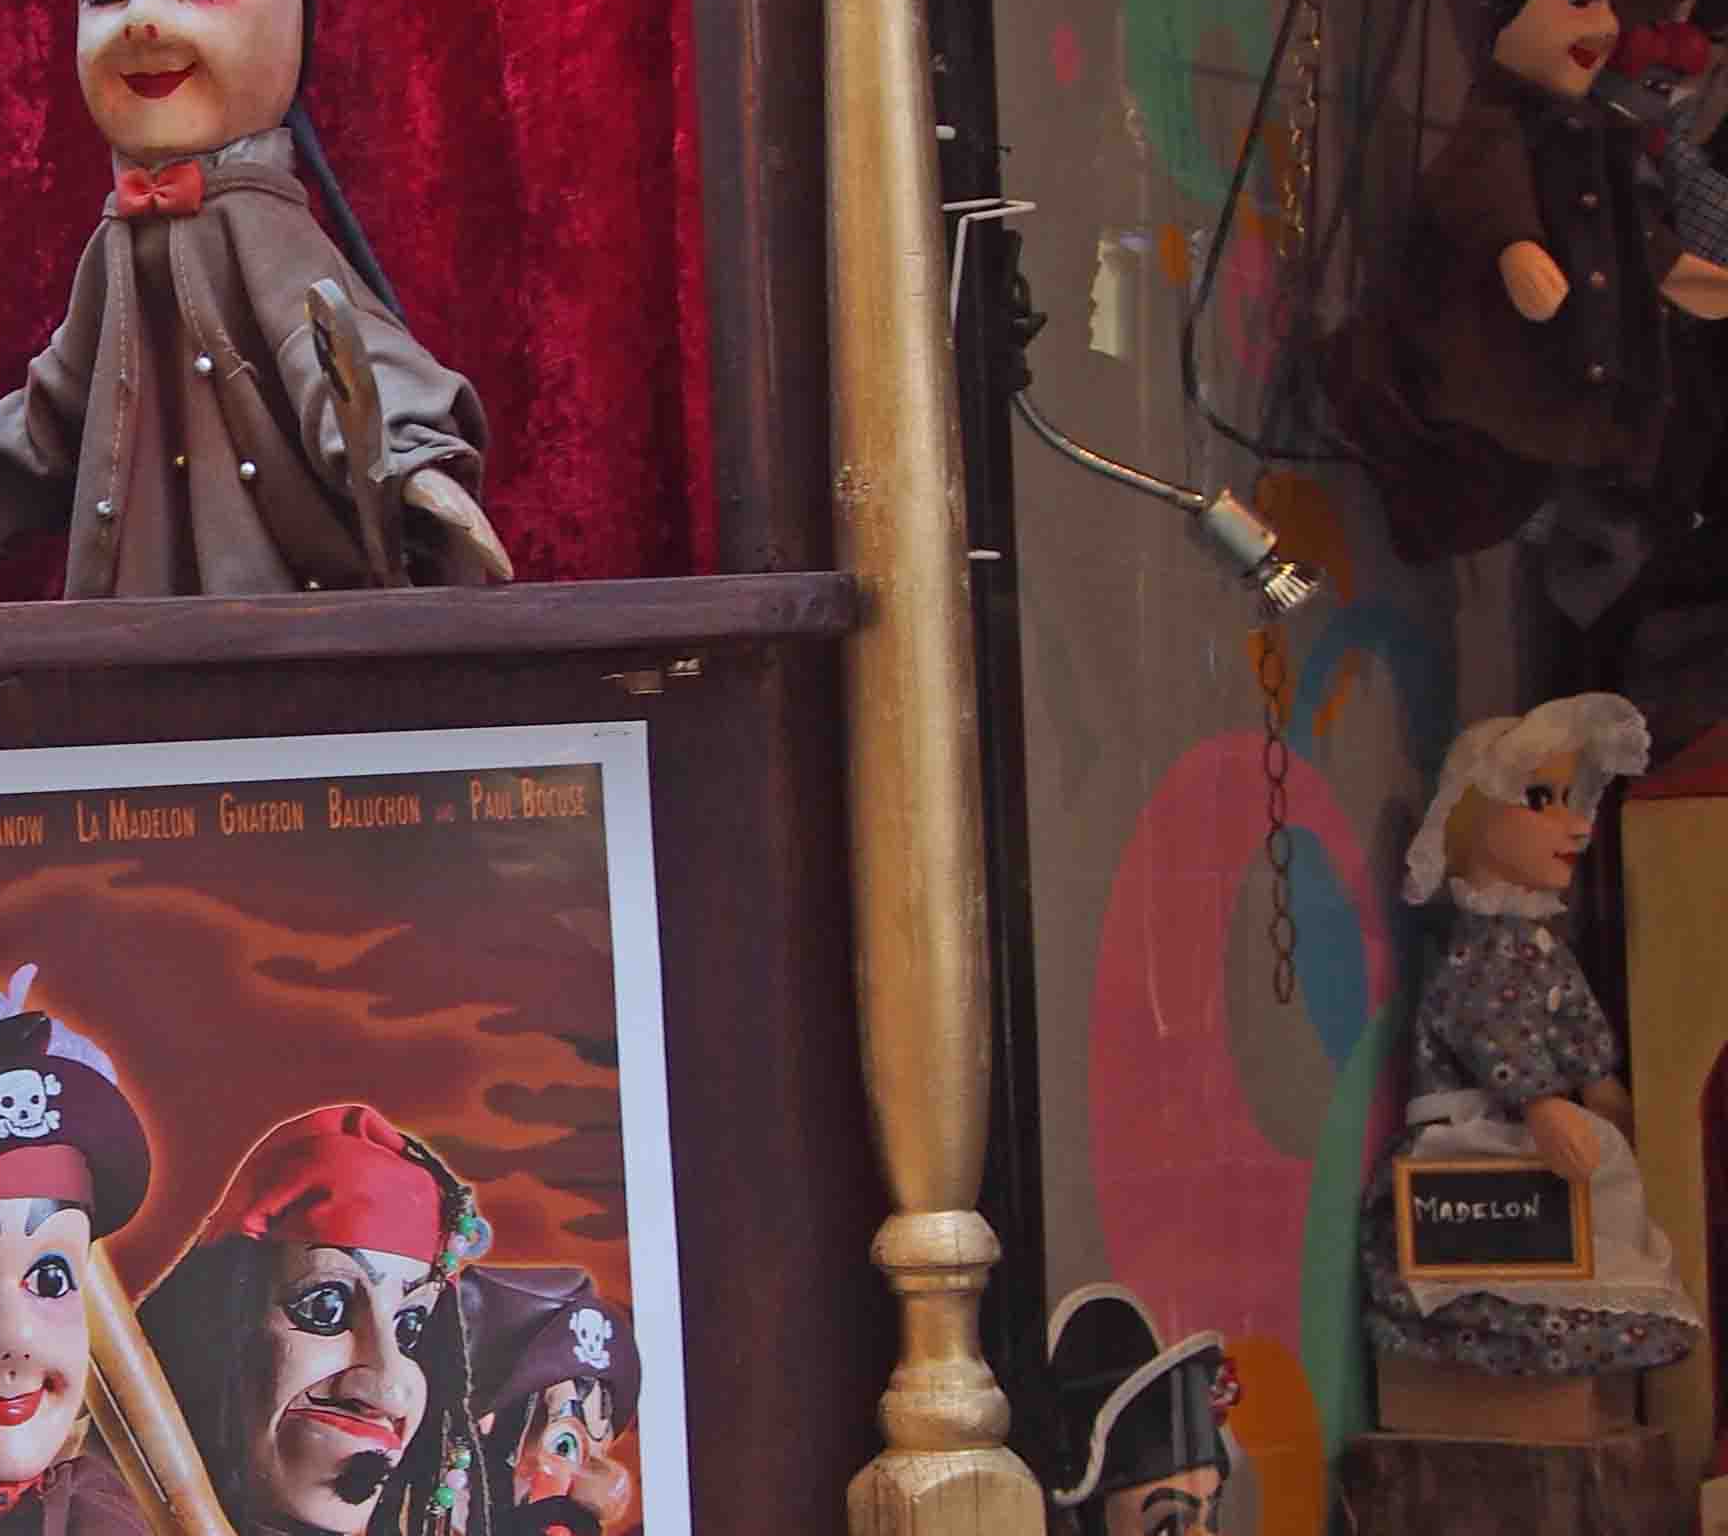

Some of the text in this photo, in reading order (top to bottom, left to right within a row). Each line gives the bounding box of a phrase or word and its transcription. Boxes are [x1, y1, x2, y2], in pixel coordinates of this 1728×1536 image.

[76, 799, 102, 842] LA
[110, 797, 194, 840] MADELON
[328, 786, 421, 829] BALUCHON
[1414, 1193, 1541, 1223] MADELON
